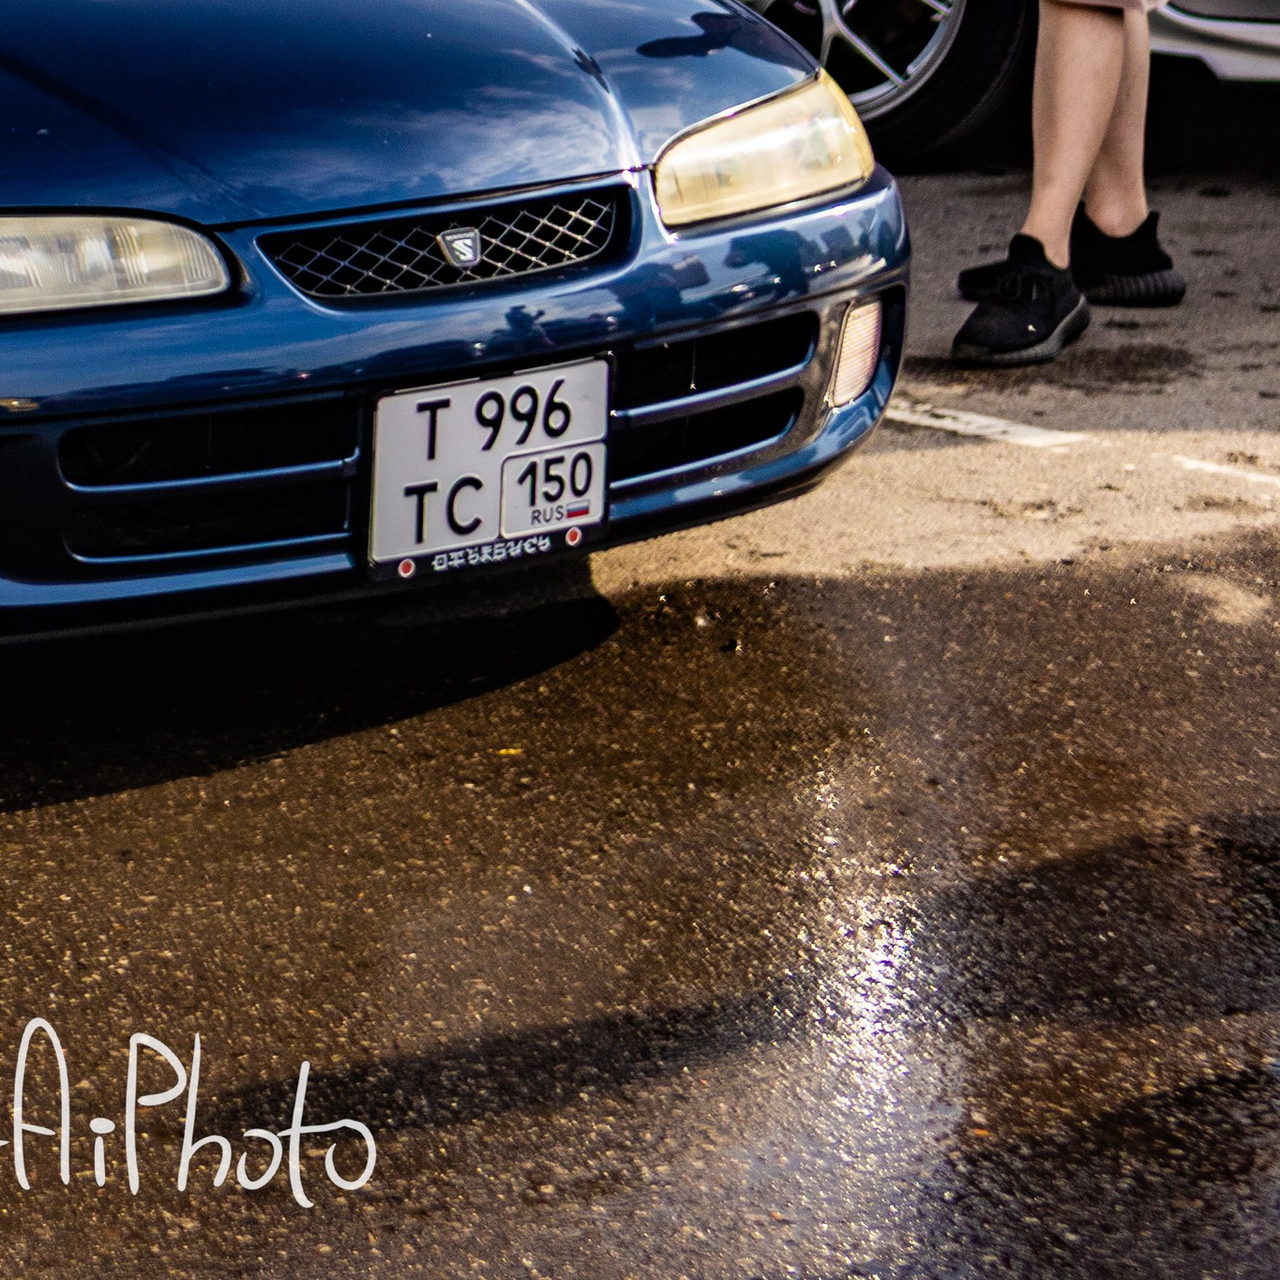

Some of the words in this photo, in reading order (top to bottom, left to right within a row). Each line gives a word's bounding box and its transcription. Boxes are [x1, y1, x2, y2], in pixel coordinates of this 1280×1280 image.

[416, 397, 451, 460] T
[475, 378, 572, 451] 996
[403, 475, 484, 545] TC
[517, 451, 593, 508] 150
[530, 505, 565, 526] RUS
